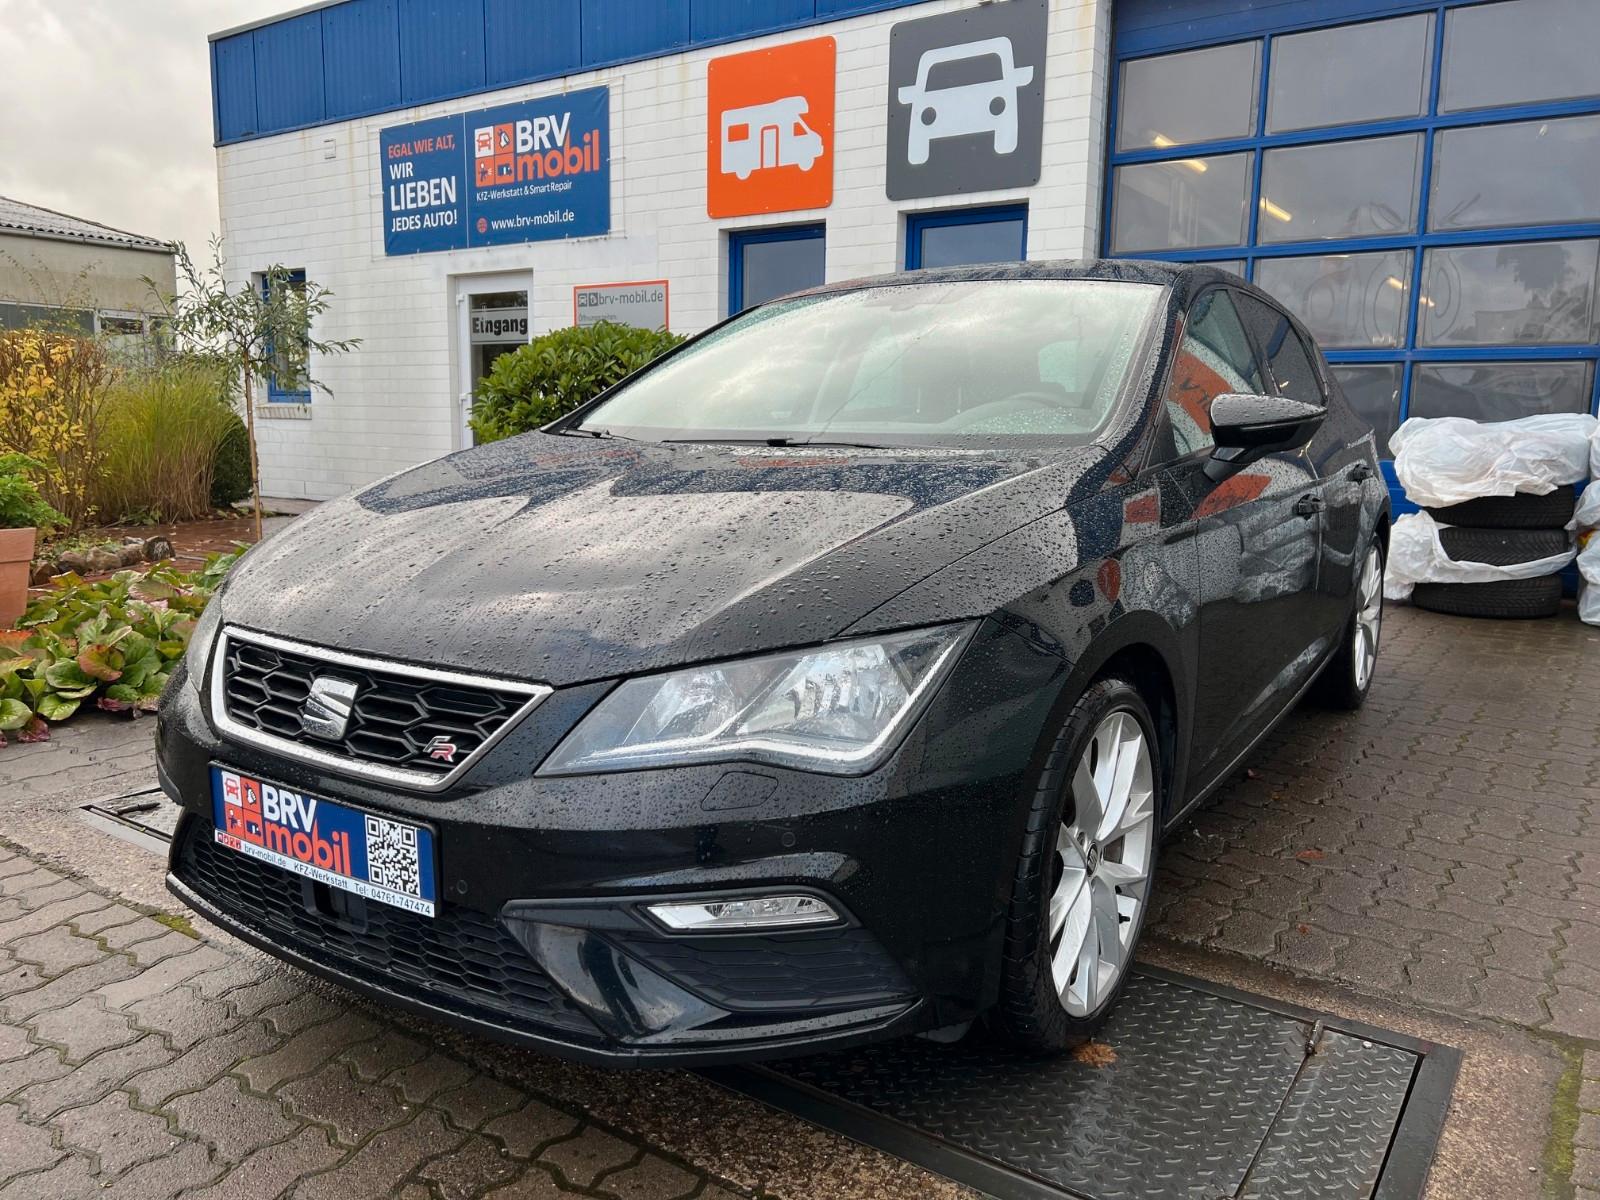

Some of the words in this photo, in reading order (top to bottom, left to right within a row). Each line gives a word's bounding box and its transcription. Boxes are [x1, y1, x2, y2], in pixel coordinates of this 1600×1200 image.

[516, 112, 570, 153] BRV
[388, 142, 412, 159] EGAL
[414, 138, 433, 154] WIE
[435, 134, 456, 151] ALT,
[517, 128, 599, 182] mobil
[389, 162, 413, 180] WIR
[390, 175, 456, 211] LIEBEN
[523, 185, 530, 195] &
[530, 182, 550, 195] Smart
[551, 179, 573, 192] Repair
[391, 214, 420, 232] JEDES
[423, 209, 458, 228] AUTO!
[491, 208, 575, 230] www.brv-mobil.de
[598, 290, 664, 305] brv-mobil.de
[472, 317, 528, 336] Eingang
[423, 735, 457, 762] FR
[261, 783, 317, 833] BRV
[265, 818, 351, 877] mobil
[244, 844, 287, 867] brv-mobil.de
[294, 862, 348, 888] KFZ-Werkstatt
[354, 882, 369, 895] Tel:
[371, 888, 431, 915] 04761-747474
